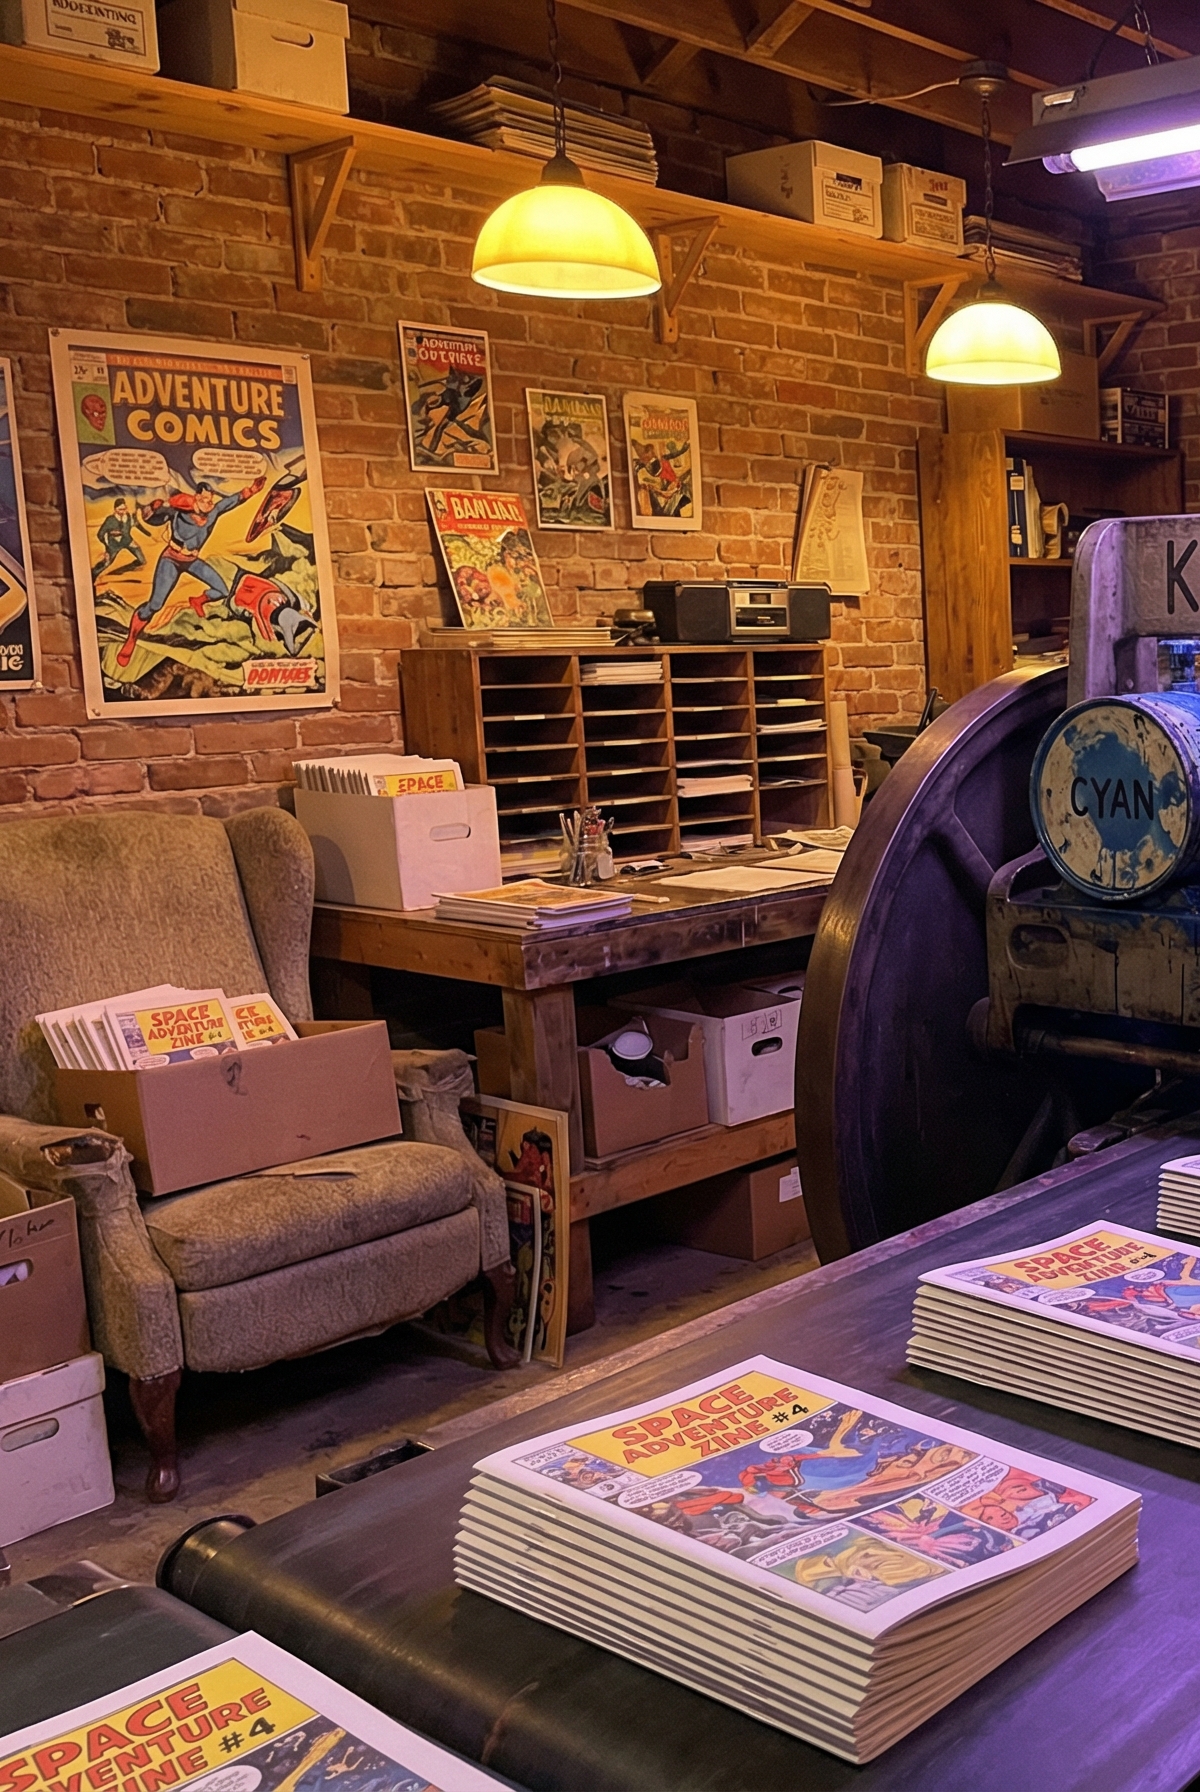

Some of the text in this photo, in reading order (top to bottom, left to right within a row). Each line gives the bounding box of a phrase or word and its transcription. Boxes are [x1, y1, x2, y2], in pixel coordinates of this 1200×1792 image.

[113, 370, 285, 418] ADVENTURE
[126, 409, 281, 450] COMICS
[1070, 776, 1154, 821] CYAN
[150, 1004, 211, 1028] SPACE
[169, 1032, 206, 1050] ZINE
[1013, 1237, 1112, 1273] SPACE
[611, 1384, 755, 1447] SPACE
[622, 1387, 799, 1465] ADVENTURE
[690, 1419, 771, 1458] ZINE
[0, 1682, 209, 1792] SPACE
[36, 1687, 272, 1792] VENTURE
[103, 1745, 209, 1792] INE
[218, 1716, 276, 1754] #4
